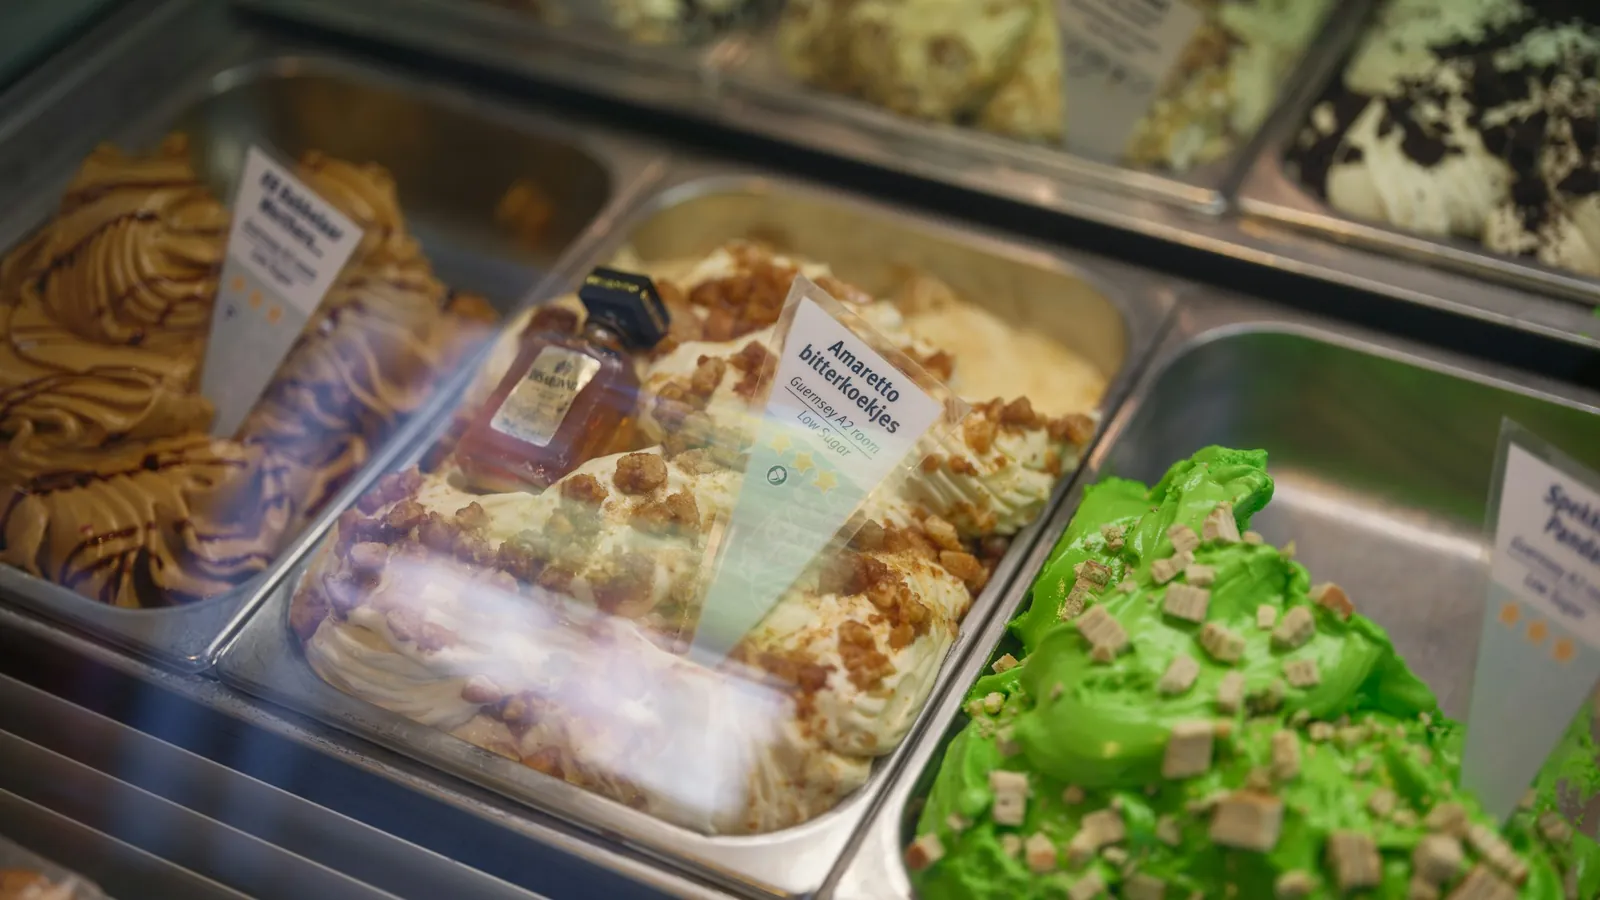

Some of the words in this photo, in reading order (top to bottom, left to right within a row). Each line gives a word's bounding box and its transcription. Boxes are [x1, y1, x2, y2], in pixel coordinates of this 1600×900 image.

[798, 343, 900, 434] bitterkoekjes
[827, 340, 900, 402] Amaretto
[790, 376, 838, 419] Guernsey
[835, 415, 854, 430] A2
[850, 427, 881, 455] room
[797, 410, 820, 431] Low
[817, 427, 852, 457] Sugar
